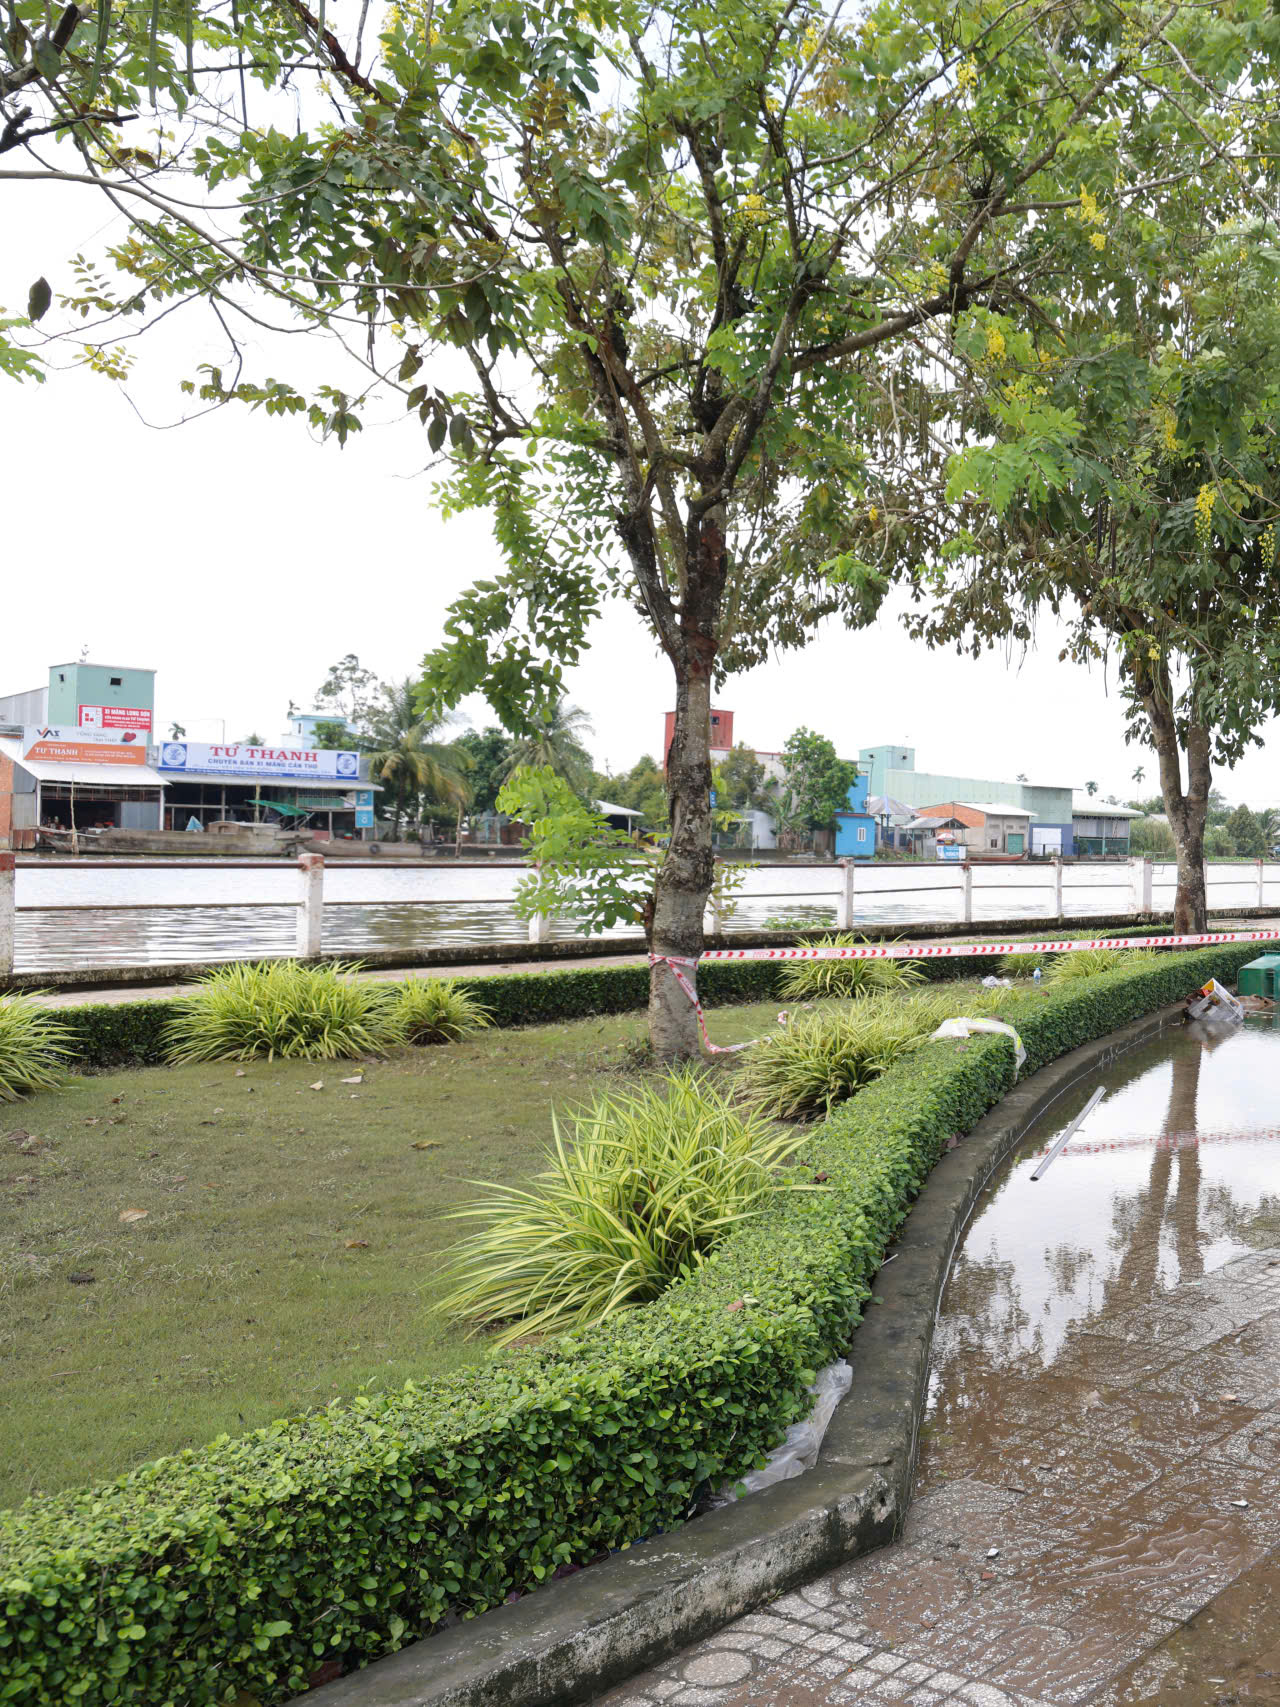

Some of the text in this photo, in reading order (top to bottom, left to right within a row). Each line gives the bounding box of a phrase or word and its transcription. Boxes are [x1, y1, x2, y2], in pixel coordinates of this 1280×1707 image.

[209, 745, 318, 763] TƯ THẠNH
[265, 760, 286, 768] MĂNG
